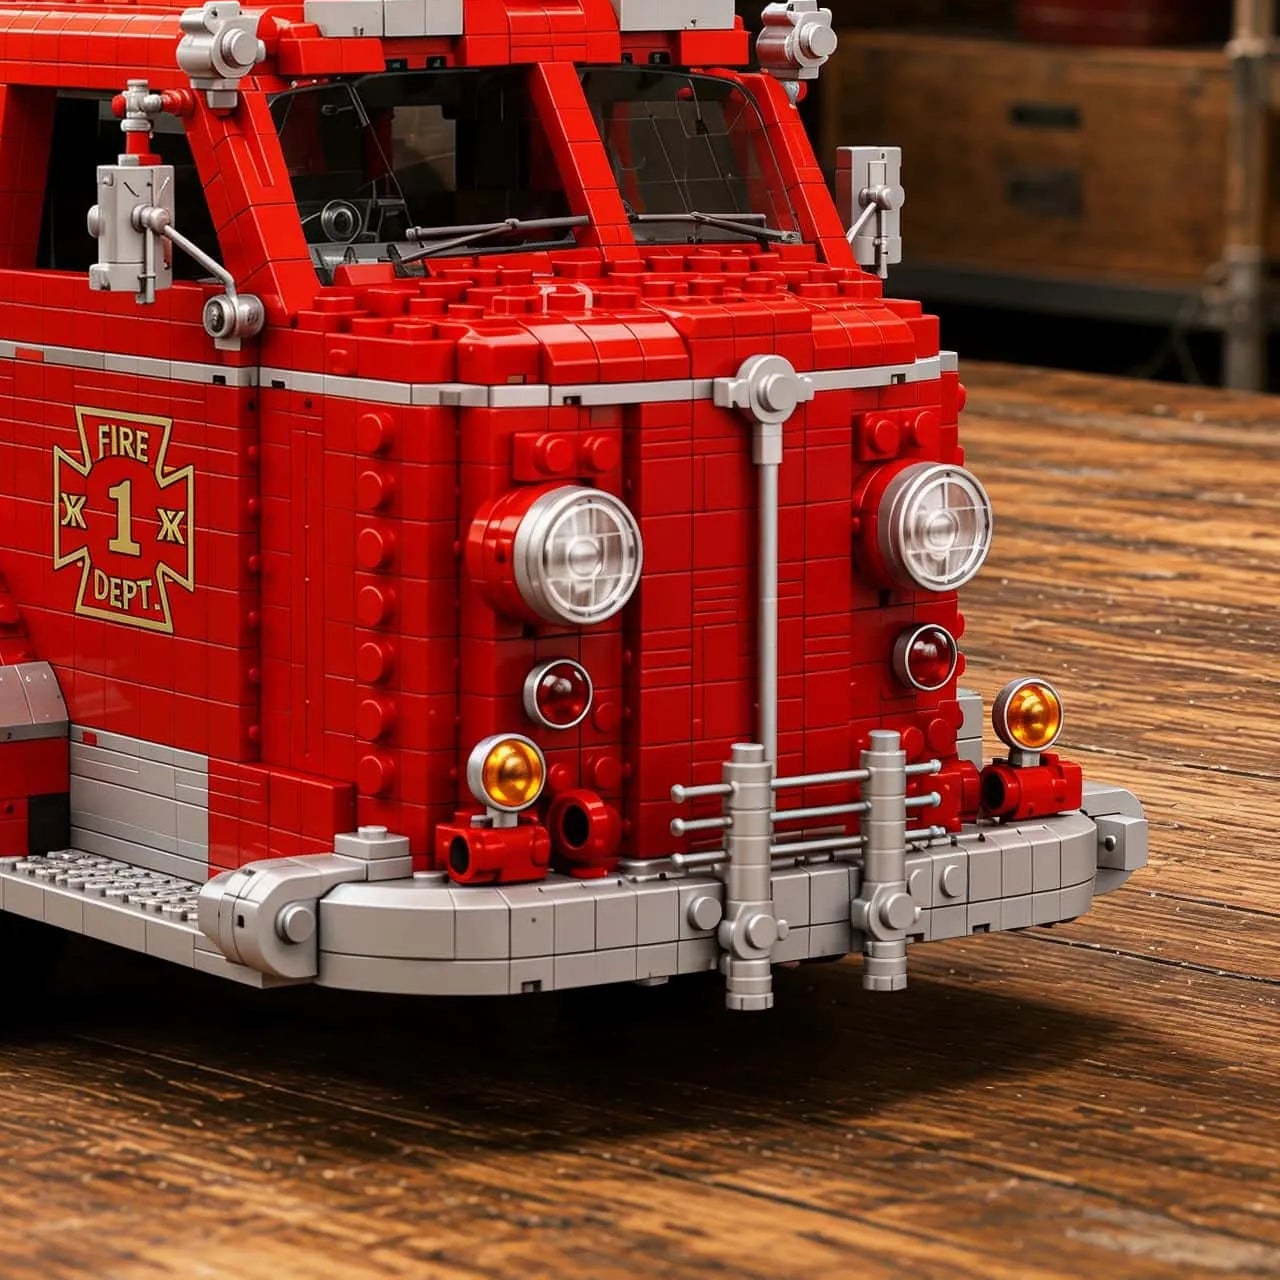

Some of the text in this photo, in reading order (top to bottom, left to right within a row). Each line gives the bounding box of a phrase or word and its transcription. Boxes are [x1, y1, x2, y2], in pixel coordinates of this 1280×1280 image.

[98, 424, 149, 463] FIRE
[108, 479, 141, 557] 1
[93, 569, 161, 611] DEPT.
